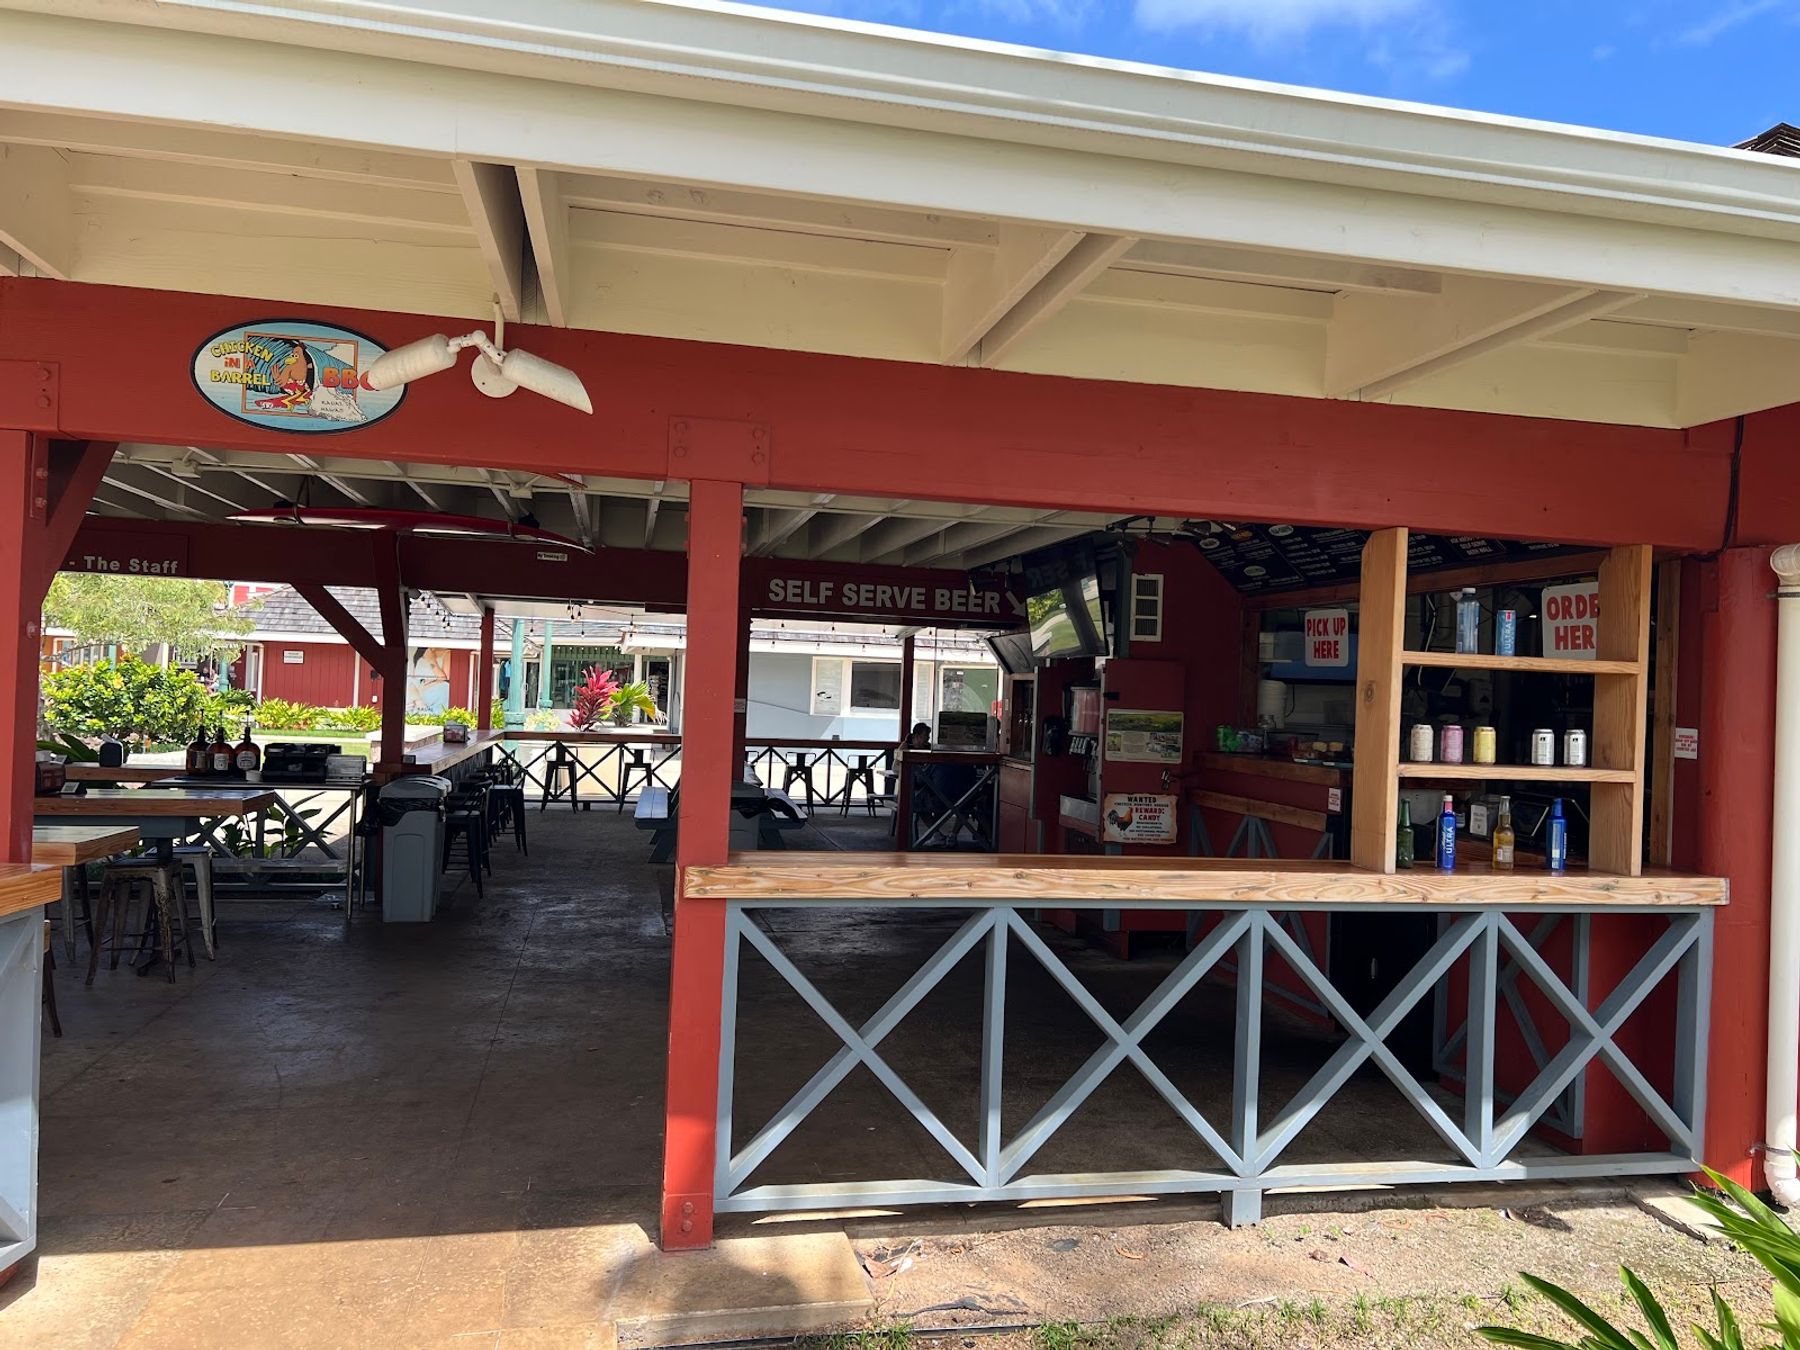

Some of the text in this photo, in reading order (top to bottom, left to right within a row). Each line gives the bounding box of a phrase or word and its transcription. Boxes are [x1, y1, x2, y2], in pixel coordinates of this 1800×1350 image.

[210, 340, 274, 363] CHICKEN
[244, 360, 256, 369] A
[210, 369, 272, 386] BARREL
[83, 555, 121, 571] The
[128, 558, 178, 574] Staff
[768, 578, 1001, 614] SELF SERVE BEER
[1546, 593, 1599, 621] ORDE
[1306, 617, 1346, 637] PICK UP
[1504, 622, 1512, 649] ULTRA
[1554, 624, 1595, 650] HER
[1313, 640, 1339, 659] HERE
[1135, 807, 1165, 815] REWARD:
[1445, 826, 1454, 854] ULTRA
